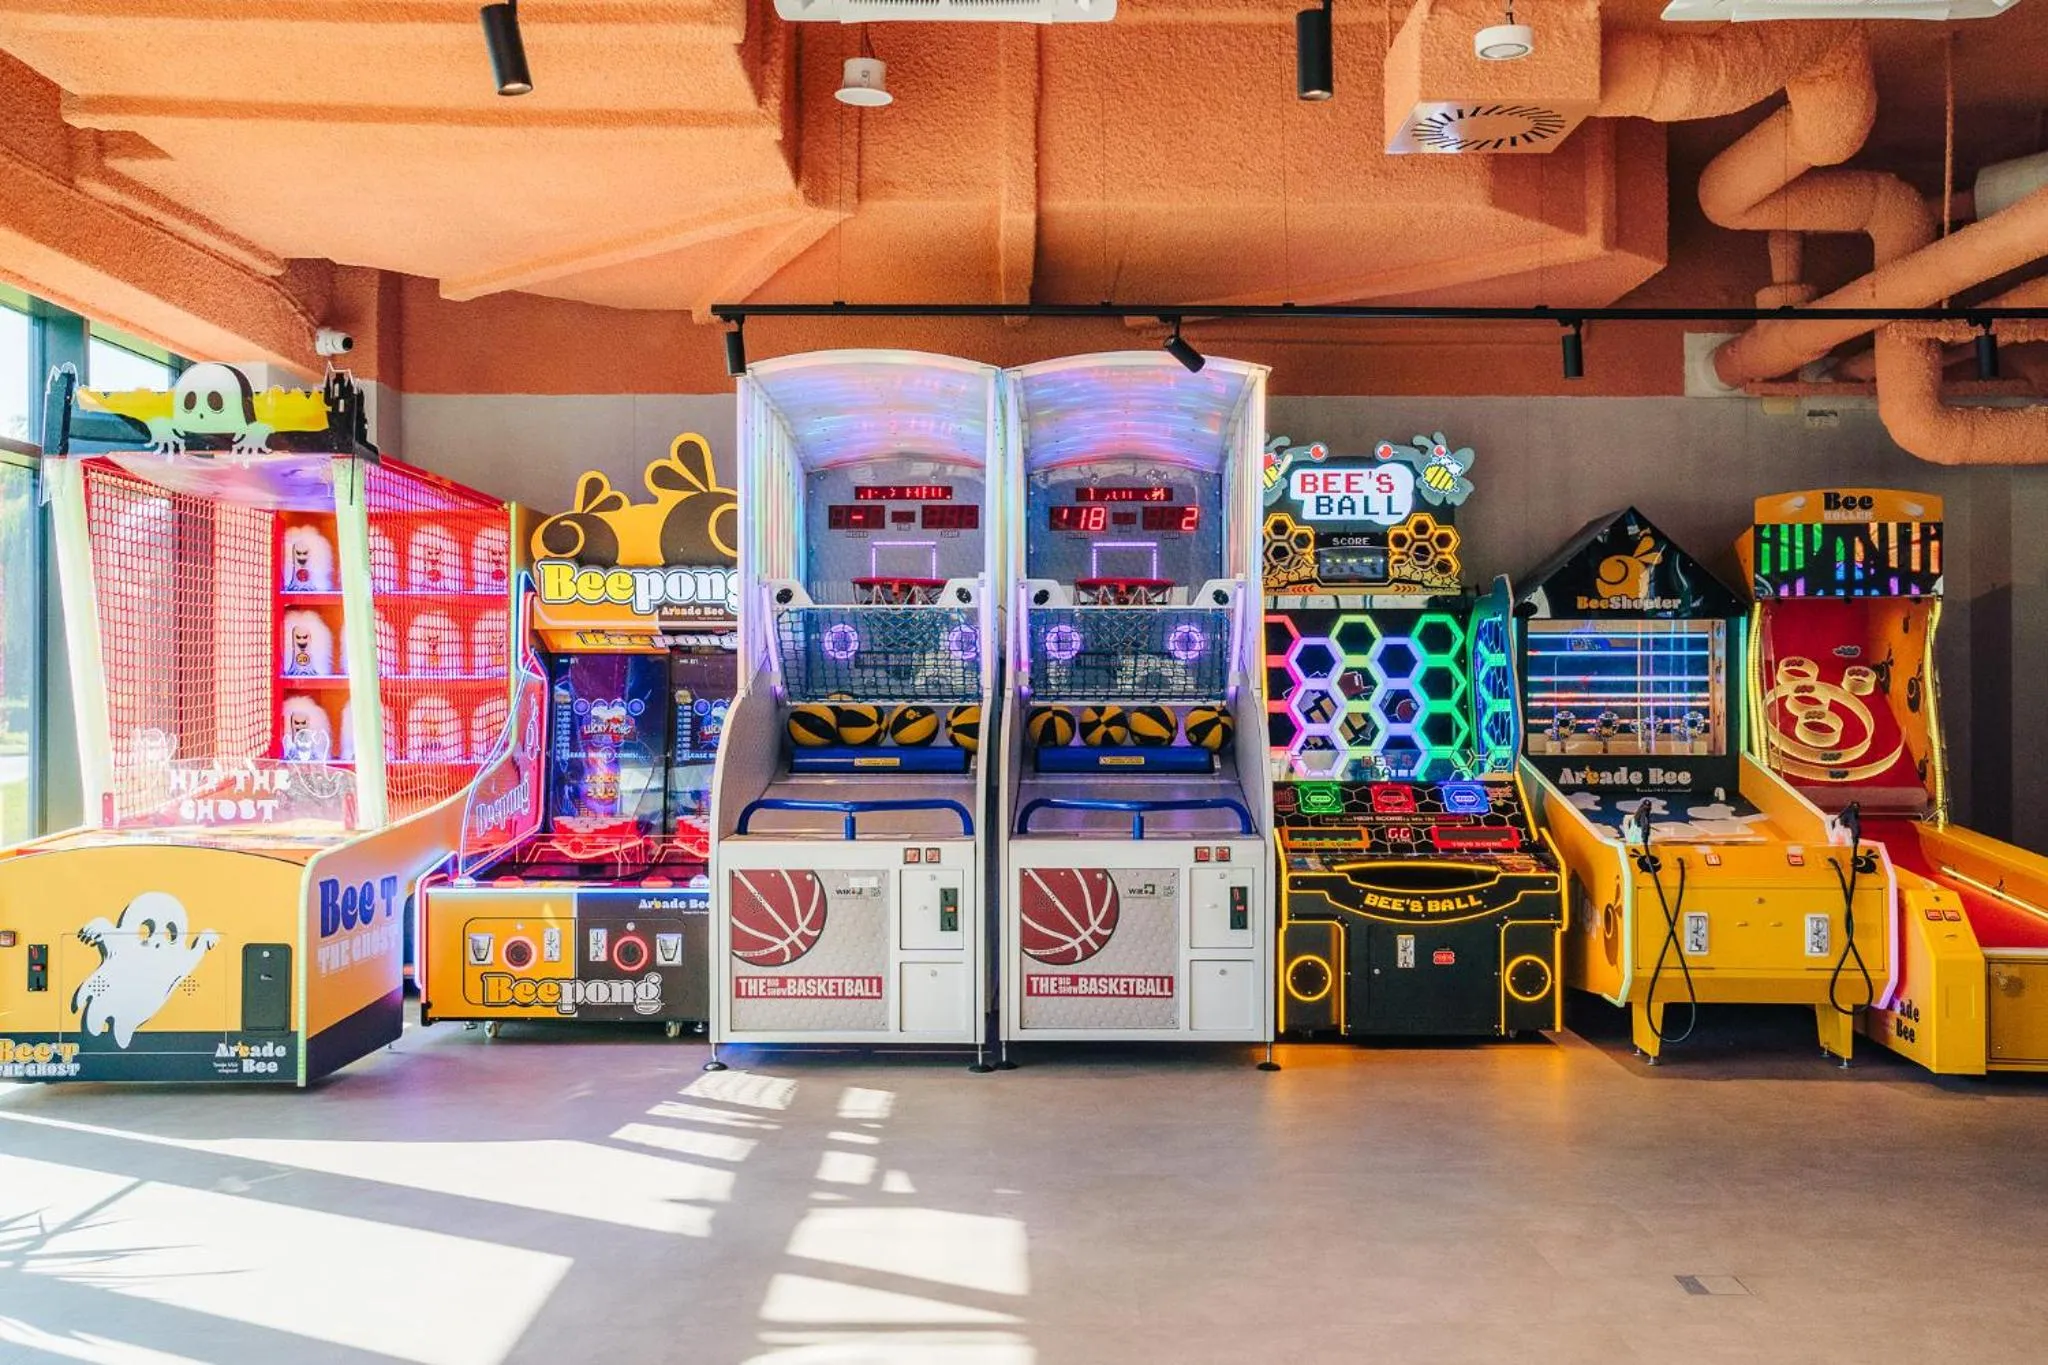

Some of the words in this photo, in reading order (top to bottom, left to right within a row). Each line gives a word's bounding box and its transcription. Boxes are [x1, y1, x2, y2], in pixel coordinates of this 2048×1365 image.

[1300, 471, 1395, 494] BEE'S
[1315, 495, 1402, 516] BALL
[1823, 492, 1874, 511] Bee
[1332, 537, 1371, 546] SCORE
[1559, 765, 1643, 785] Arcade
[1648, 767, 1692, 785] Bee
[638, 898, 686, 909] Arcade
[1364, 892, 1423, 913] BEE'S
[1427, 894, 1483, 913] BALL
[482, 971, 663, 1015] Beepong
[738, 978, 766, 996] THE
[787, 978, 881, 997] BASKETBALL
[1030, 977, 1058, 994] THE
[1078, 977, 1172, 996] BASKETBALL
[1896, 1017, 1915, 1043] Bee
[215, 1041, 286, 1058] Arcade
[243, 1058, 278, 1074] Bee
